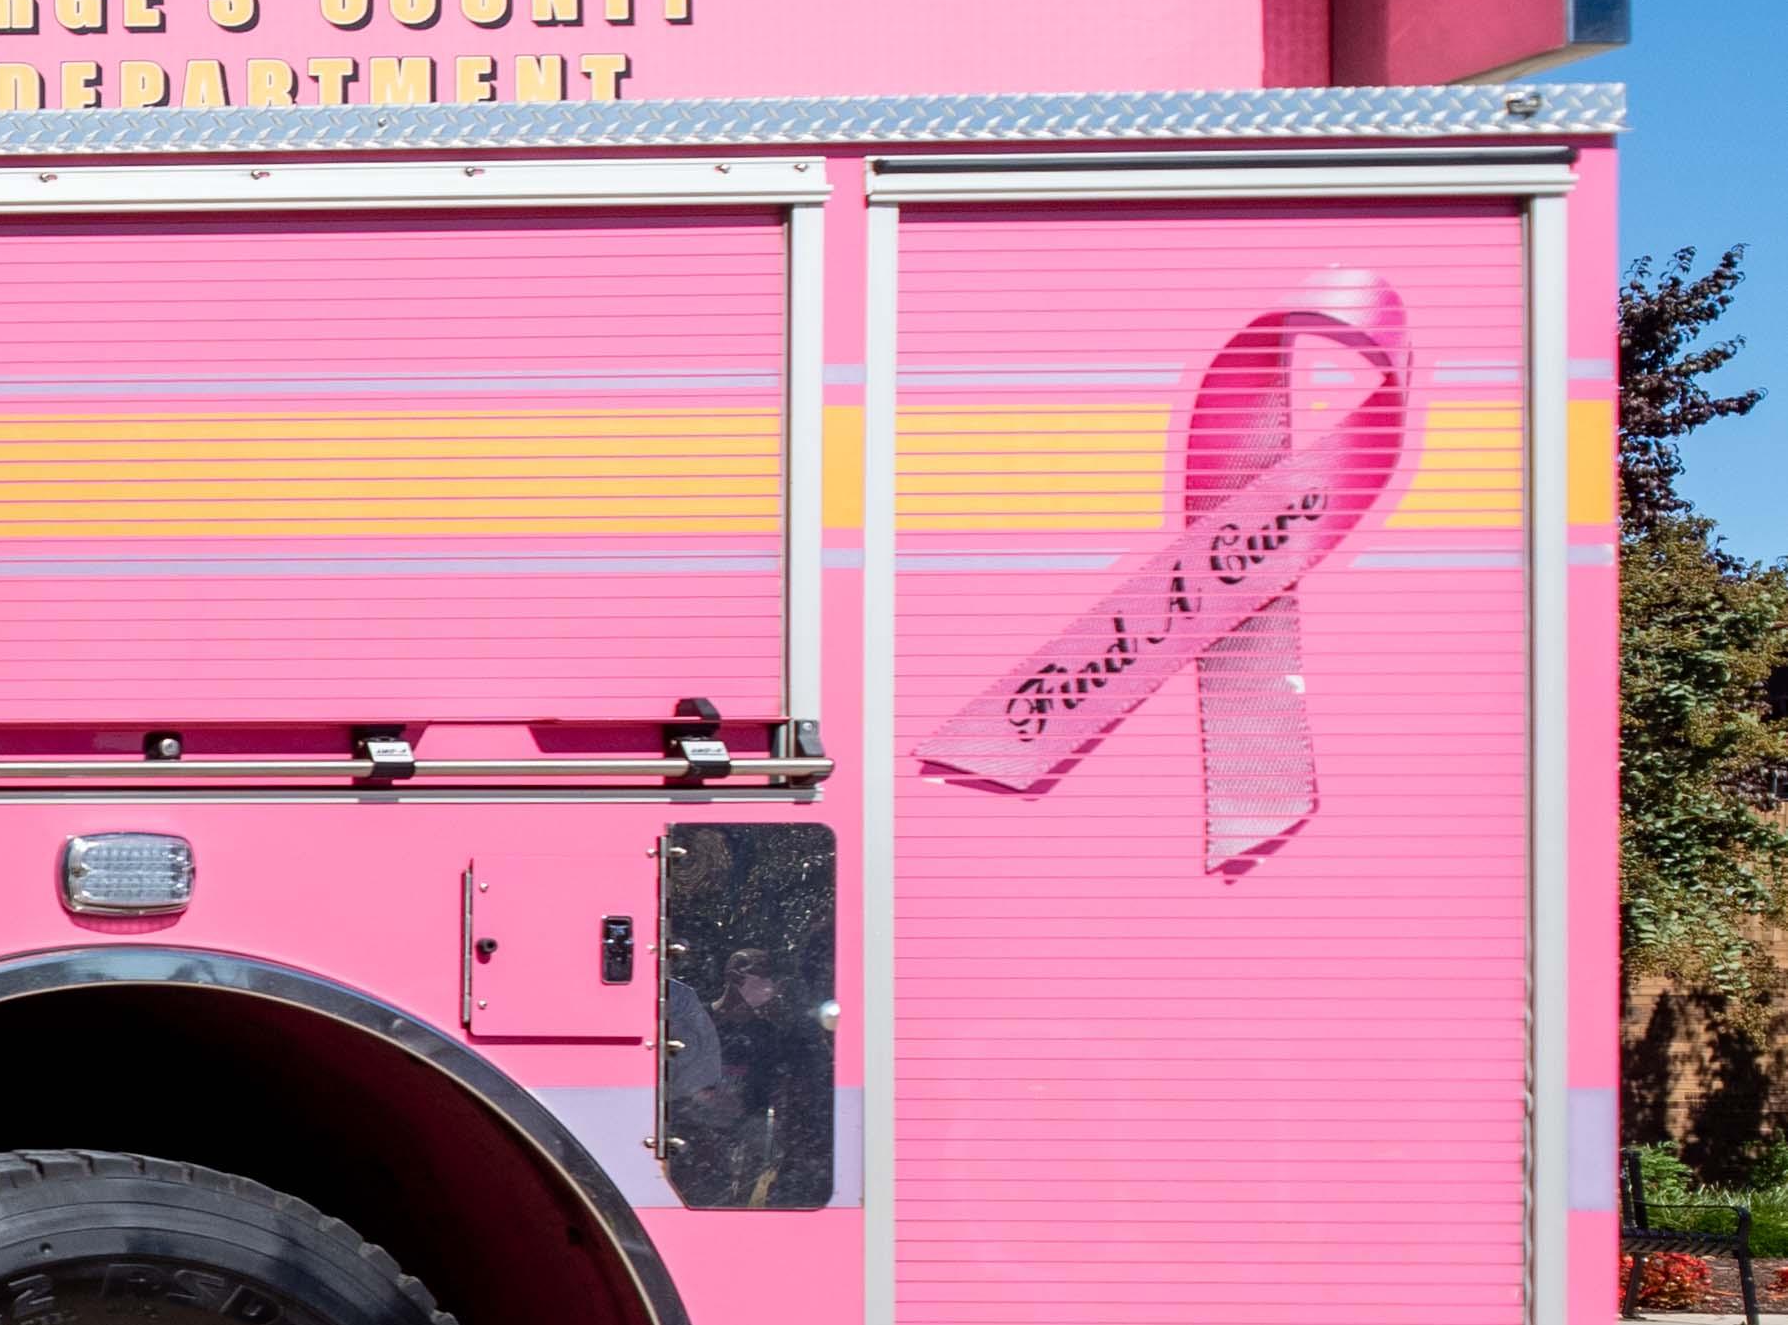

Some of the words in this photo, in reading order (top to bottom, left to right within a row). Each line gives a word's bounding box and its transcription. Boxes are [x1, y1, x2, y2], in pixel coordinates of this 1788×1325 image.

[1005, 610, 1138, 743] Find
[1146, 560, 1202, 644] A
[1209, 486, 1328, 585] Cure
